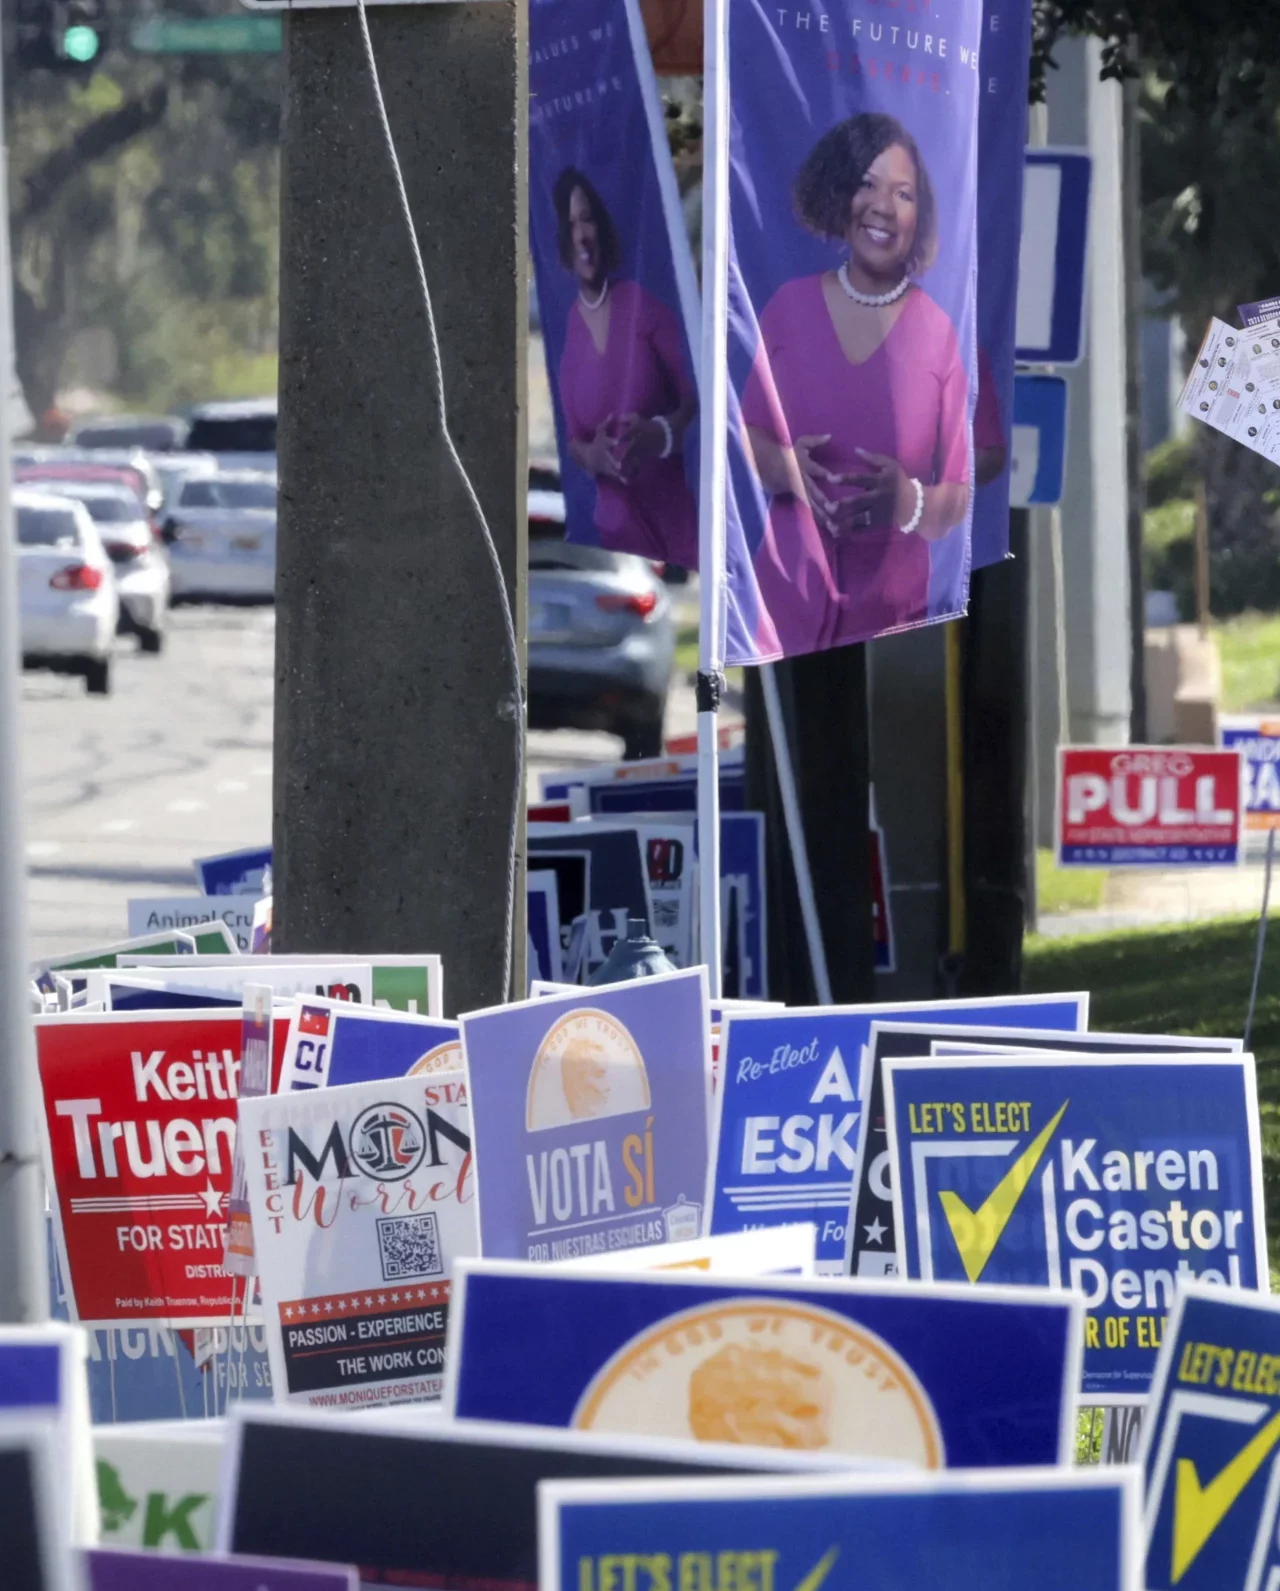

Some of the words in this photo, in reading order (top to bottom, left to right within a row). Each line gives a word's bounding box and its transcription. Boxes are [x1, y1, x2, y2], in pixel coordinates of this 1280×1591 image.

[777, 9, 830, 33] THE
[852, 19, 947, 58] FUTURE
[959, 45, 978, 71] WE
[1110, 754, 1195, 777] GREG
[1066, 773, 1234, 826] PULL
[130, 1049, 241, 1102] Keith
[736, 1037, 820, 1084] Re-Elect
[908, 1101, 967, 1134] LET'S
[971, 1101, 1033, 1133] ELECT
[259, 1129, 285, 1234] ELECT
[526, 1140, 615, 1226] VOTA
[622, 1115, 655, 1208] SÍ
[1061, 1138, 1219, 1192] Karen
[116, 1224, 164, 1252] FOR
[551, 1231, 607, 1263] NUESTRAS
[608, 1220, 663, 1250] ESCUELAS
[1064, 1198, 1244, 1252] Castor
[116, 1297, 133, 1308] Paid
[134, 1297, 143, 1309] by
[144, 1296, 165, 1308] Keith
[288, 1324, 347, 1349] PASSION
[358, 1312, 444, 1339] EXPERIENCE
[1104, 1316, 1130, 1348] OF
[218, 1362, 248, 1388] FOR
[337, 1357, 367, 1376] THE
[369, 1351, 414, 1373] WORK
[664, 1318, 724, 1357] GOD
[811, 1325, 900, 1393] TRUST
